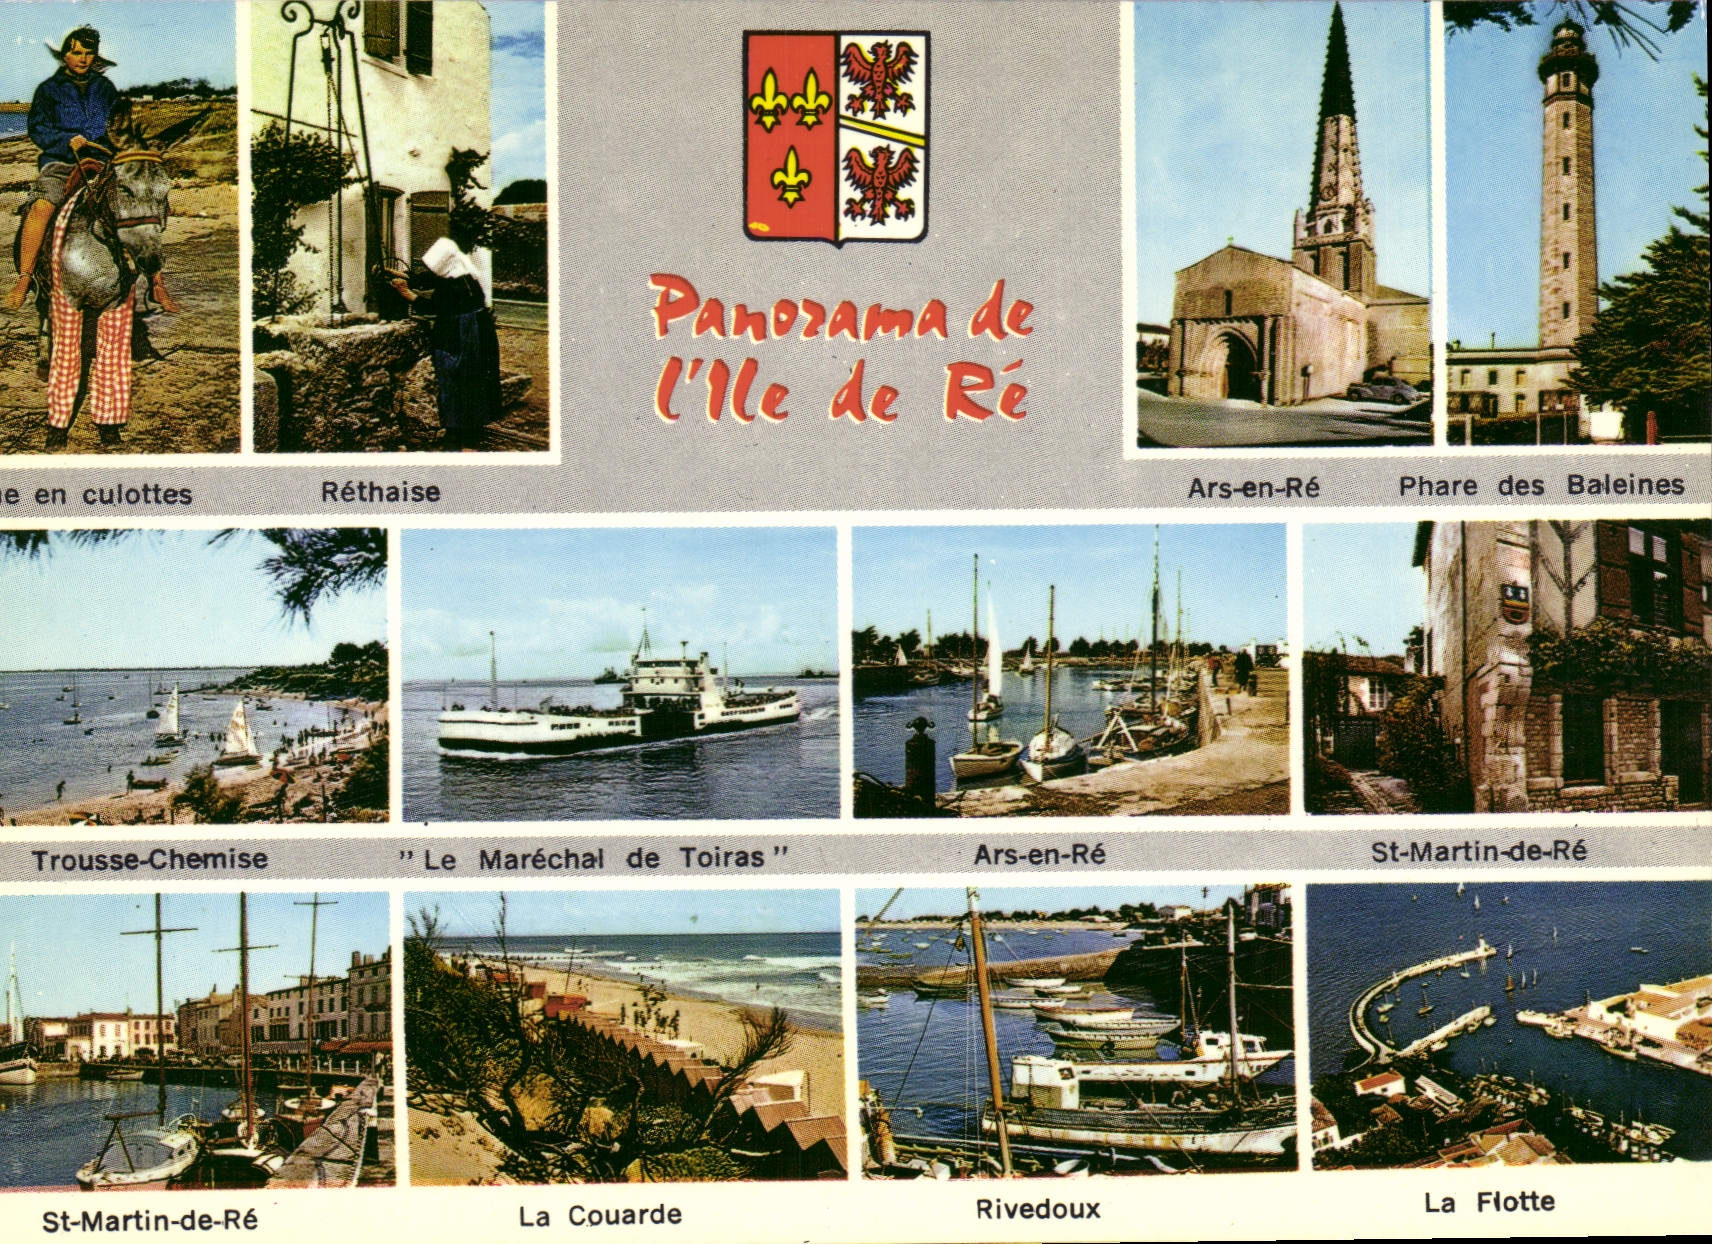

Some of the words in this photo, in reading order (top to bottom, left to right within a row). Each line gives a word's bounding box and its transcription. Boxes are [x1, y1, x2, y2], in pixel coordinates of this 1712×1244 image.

[648, 273, 949, 343] Panorama
[968, 279, 1034, 341] de
[828, 358, 899, 423] de
[944, 359, 1028, 423] Ré
[0, 488, 20, 505] e
[35, 488, 66, 505] en
[83, 483, 193, 506] culottes
[322, 480, 441, 503] Réthaise
[1188, 476, 1320, 499] Ars-en-Ré
[1400, 475, 1478, 496] Phare
[1498, 474, 1545, 496] des
[1567, 473, 1685, 496] Baleines
[31, 847, 268, 872] Trousse-Chemise
[479, 848, 604, 870] Maréchal
[626, 847, 660, 869] de
[974, 842, 1106, 866] Ars-en-Ré
[1372, 839, 1588, 863] St-Martin-de-Ré
[977, 1198, 1100, 1219] Rivedoux
[1425, 1192, 1455, 1213] La
[1478, 1191, 1555, 1212] Flotte
[42, 1208, 258, 1233] St-Martin-de-Ré
[520, 1206, 550, 1227] La
[569, 1204, 682, 1226] Couarde
